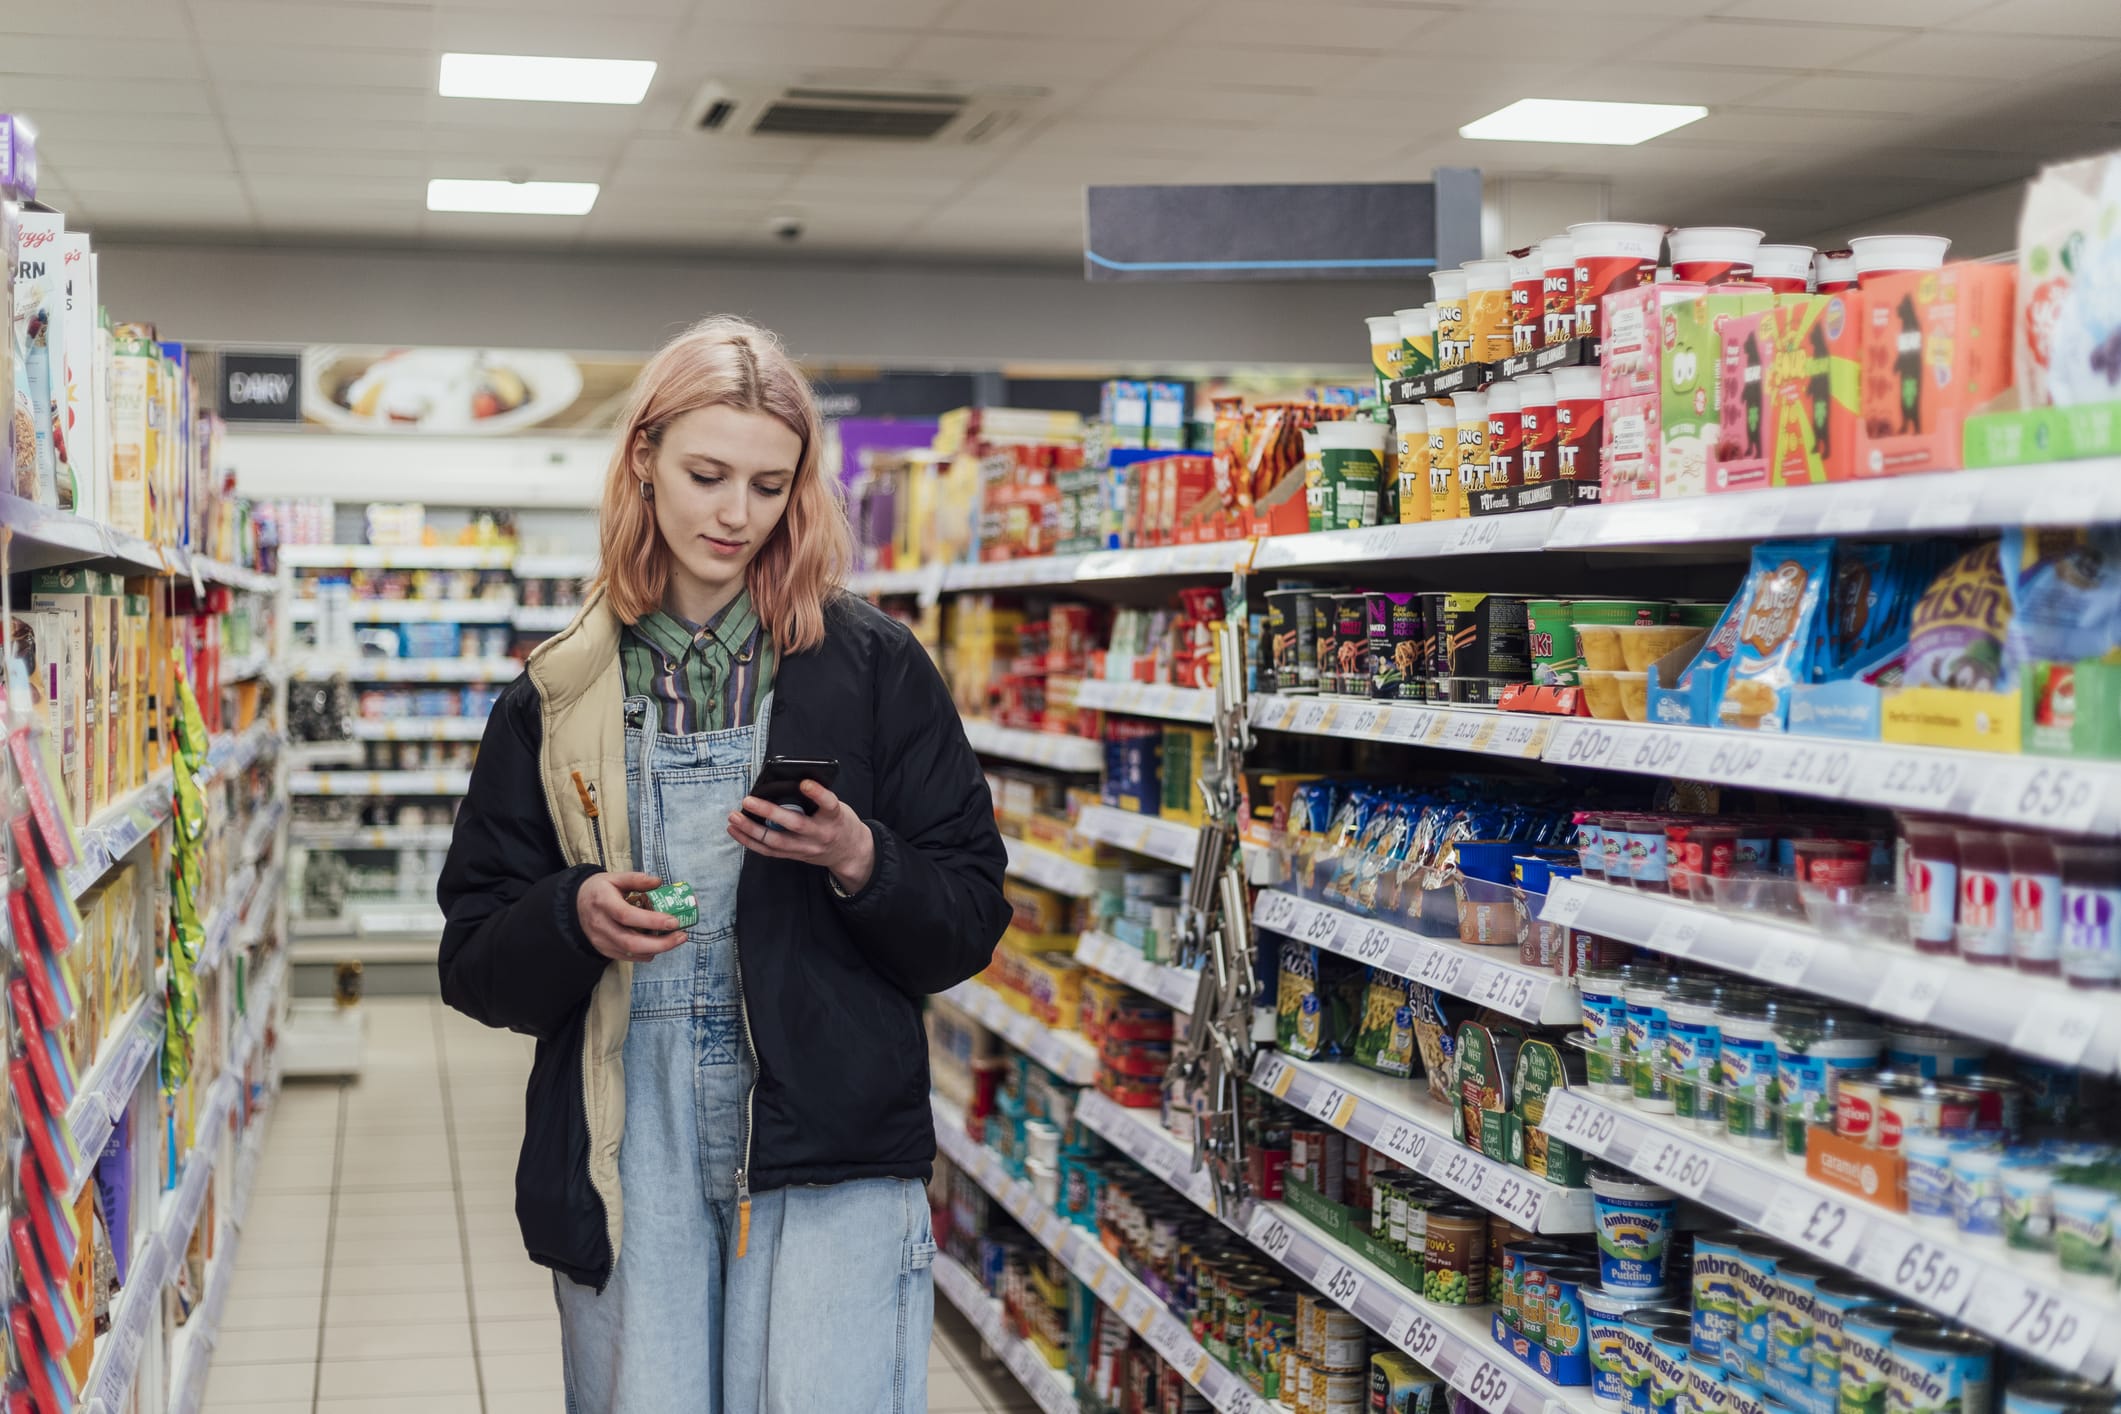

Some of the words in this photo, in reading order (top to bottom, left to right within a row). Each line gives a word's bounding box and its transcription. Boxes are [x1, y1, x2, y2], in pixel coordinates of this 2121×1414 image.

[17, 224, 55, 248] logg's
[15, 261, 45, 279] RN
[1575, 267, 1588, 282] NG
[1544, 278, 1567, 292] ING
[1512, 290, 1528, 304] NG
[1439, 307, 1462, 321] ING
[1544, 313, 1576, 337] OT
[1513, 325, 1536, 347] OT
[1439, 340, 1470, 361] OT
[1521, 414, 1537, 429] NG
[1557, 409, 1571, 424] NG
[1458, 430, 1482, 445] ING
[1488, 421, 1504, 435] NG
[1429, 435, 1444, 449] NG
[1489, 455, 1512, 477] OT
[1523, 450, 1545, 472] OT
[1430, 466, 1452, 488] OT
[1459, 464, 1490, 486] OT
[1744, 609, 1791, 647] Delight
[1410, 712, 1434, 741] £1
[1307, 911, 1337, 940] 85p
[1358, 928, 1390, 959] 85p
[1421, 951, 1464, 986] £1.15
[1487, 971, 1533, 1010] £1.15
[1583, 1009, 1604, 1028] rosia
[1465, 1034, 1480, 1049] JOHN
[1670, 1036, 1692, 1058] rosia
[1467, 1047, 1481, 1062] WEST
[1529, 1051, 1546, 1067] JOHN
[1723, 1053, 1748, 1074] rosia
[1263, 1062, 1283, 1089] £1
[1531, 1065, 1548, 1081] WEST
[1320, 1089, 1341, 1120] £1
[1565, 1104, 1615, 1143] £1.60
[1389, 1126, 1426, 1158] £2.30
[1445, 1153, 1487, 1192] £2.75
[1654, 1144, 1709, 1187] £1.60
[1496, 1179, 1542, 1219] £2.75
[1607, 1199, 1633, 1207] FRIDGE
[1603, 1213, 1659, 1233] Ambrosia
[1802, 1201, 1846, 1250] £2
[1261, 1220, 1290, 1252] 40p
[1427, 1239, 1456, 1252] OW'S
[1611, 1268, 1652, 1283] Pudding
[1620, 1260, 1642, 1271] Rice
[1693, 1254, 1740, 1278] Ambro
[1895, 1244, 1960, 1299] 65p
[1327, 1265, 1357, 1300] 45p
[1739, 1267, 1776, 1299] rosia
[1705, 1312, 1736, 1331] Rice
[2006, 1289, 2079, 1350] 75p
[1403, 1316, 1438, 1357] 65p
[1547, 1321, 1580, 1347] shy
[1591, 1327, 1624, 1341] Ambro
[1624, 1334, 1653, 1363] rosi
[1842, 1336, 1892, 1376] rosia
[1605, 1374, 1621, 1384] Ric
[1650, 1352, 1685, 1386] rosia
[1890, 1359, 1943, 1400] rosia
[1470, 1362, 1508, 1406] 65p
[1598, 1381, 1621, 1393] Pudd
[1689, 1371, 1728, 1406] rosia
[1727, 1393, 1763, 1414] rosi
